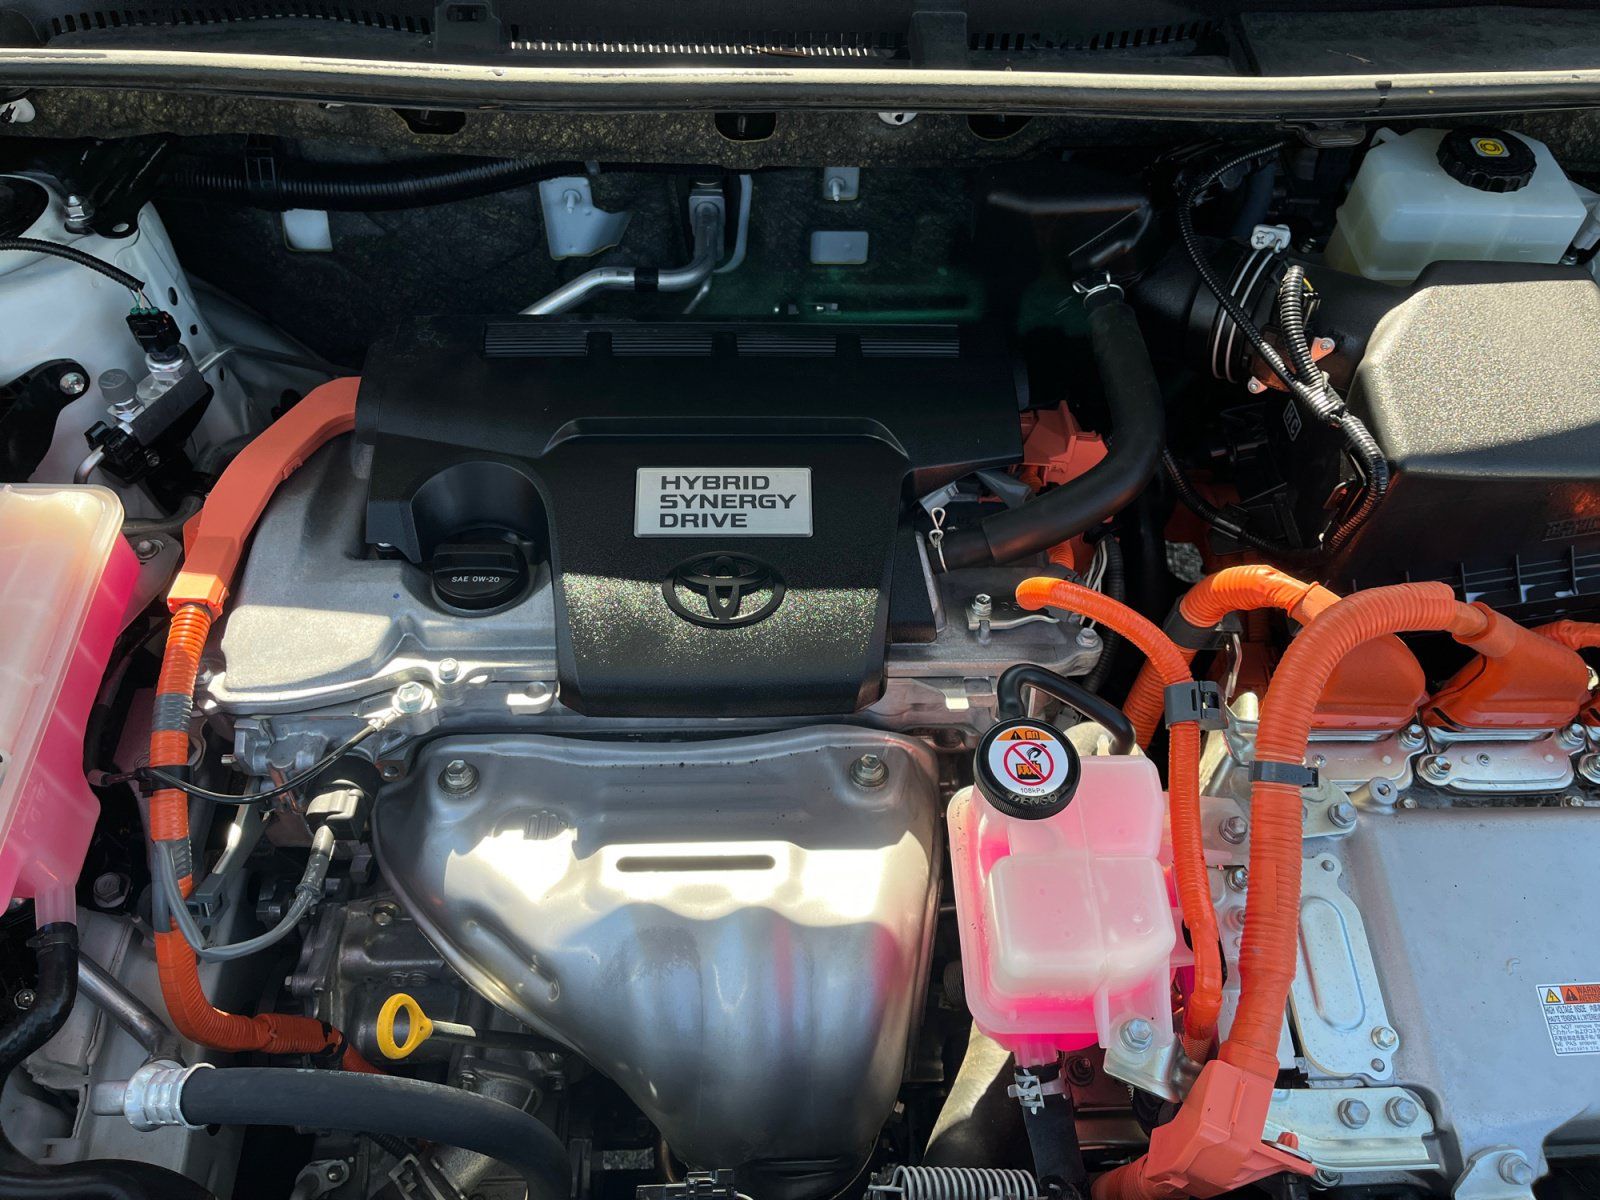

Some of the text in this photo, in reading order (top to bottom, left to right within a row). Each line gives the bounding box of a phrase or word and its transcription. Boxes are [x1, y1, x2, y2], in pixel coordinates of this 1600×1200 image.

[661, 475, 770, 490] HYBRID
[660, 494, 797, 509] SYNERGY
[659, 513, 748, 528] DRIVE
[451, 575, 500, 583] SAE 0W-20
[1010, 793, 1057, 806] DENSO
[1556, 1005, 1574, 1014] VOLTAGE
